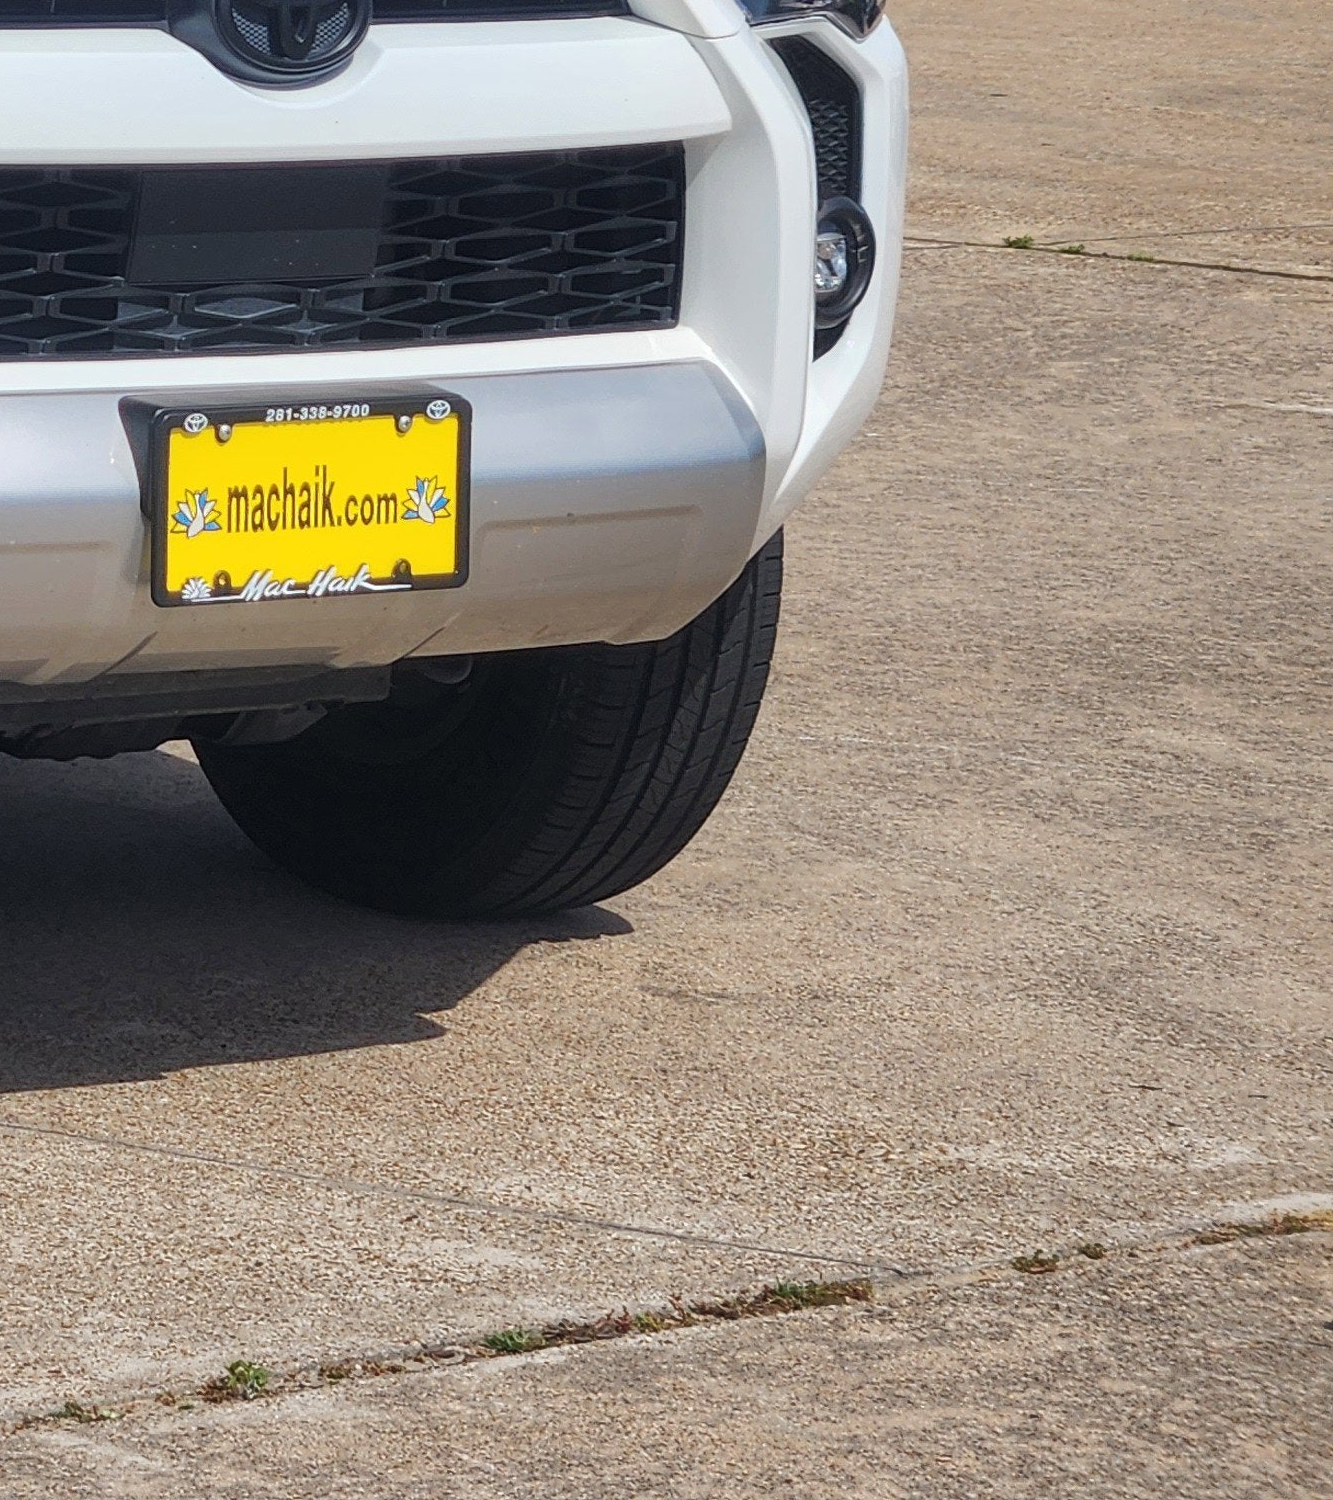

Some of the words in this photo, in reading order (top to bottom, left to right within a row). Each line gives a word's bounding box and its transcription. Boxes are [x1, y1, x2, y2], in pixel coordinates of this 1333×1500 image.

[265, 403, 370, 422] 281-338-9700
[226, 464, 399, 534] machaik.com
[240, 568, 306, 602] Mac
[306, 562, 375, 597] Haik
